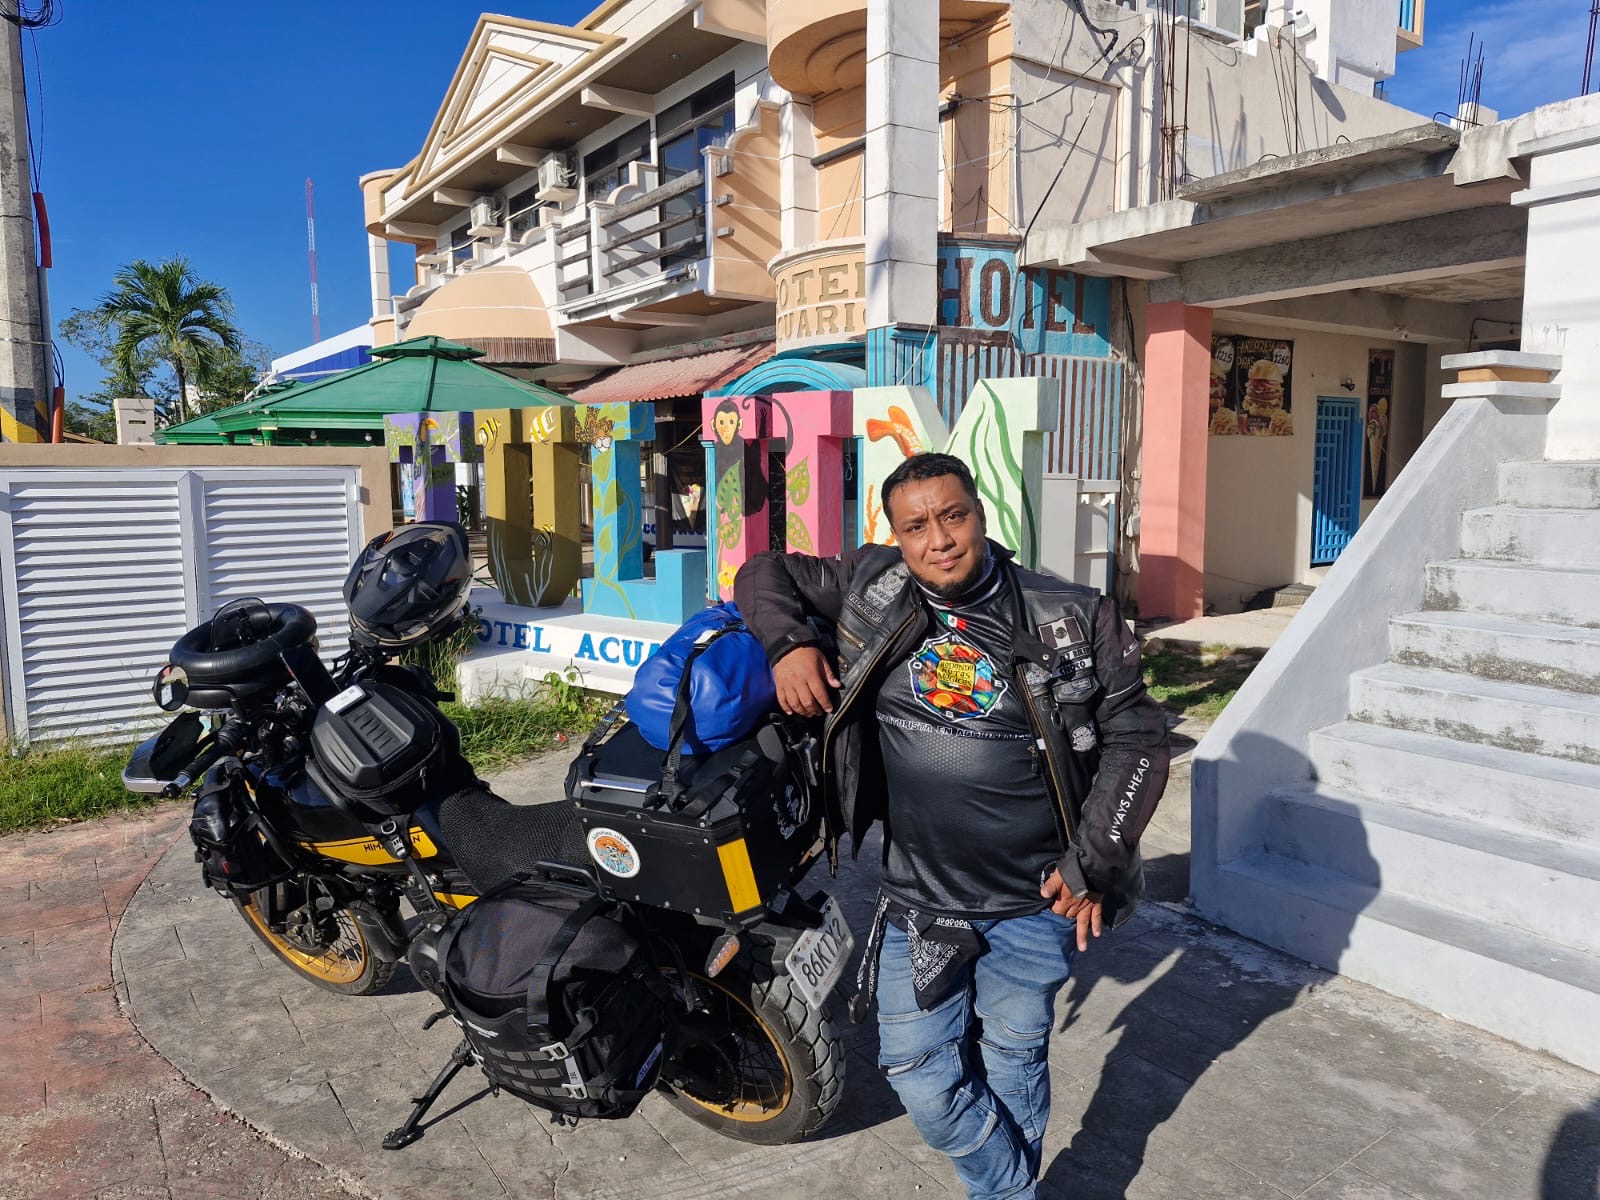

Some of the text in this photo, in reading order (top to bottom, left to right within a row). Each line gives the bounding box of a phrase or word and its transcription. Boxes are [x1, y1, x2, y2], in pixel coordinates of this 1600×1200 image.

[937, 257, 1096, 335] HOTEL
[478, 618, 552, 654] OTEL
[1126, 757, 1150, 801] AHEAD
[801, 917, 847, 987] 86KTX2
